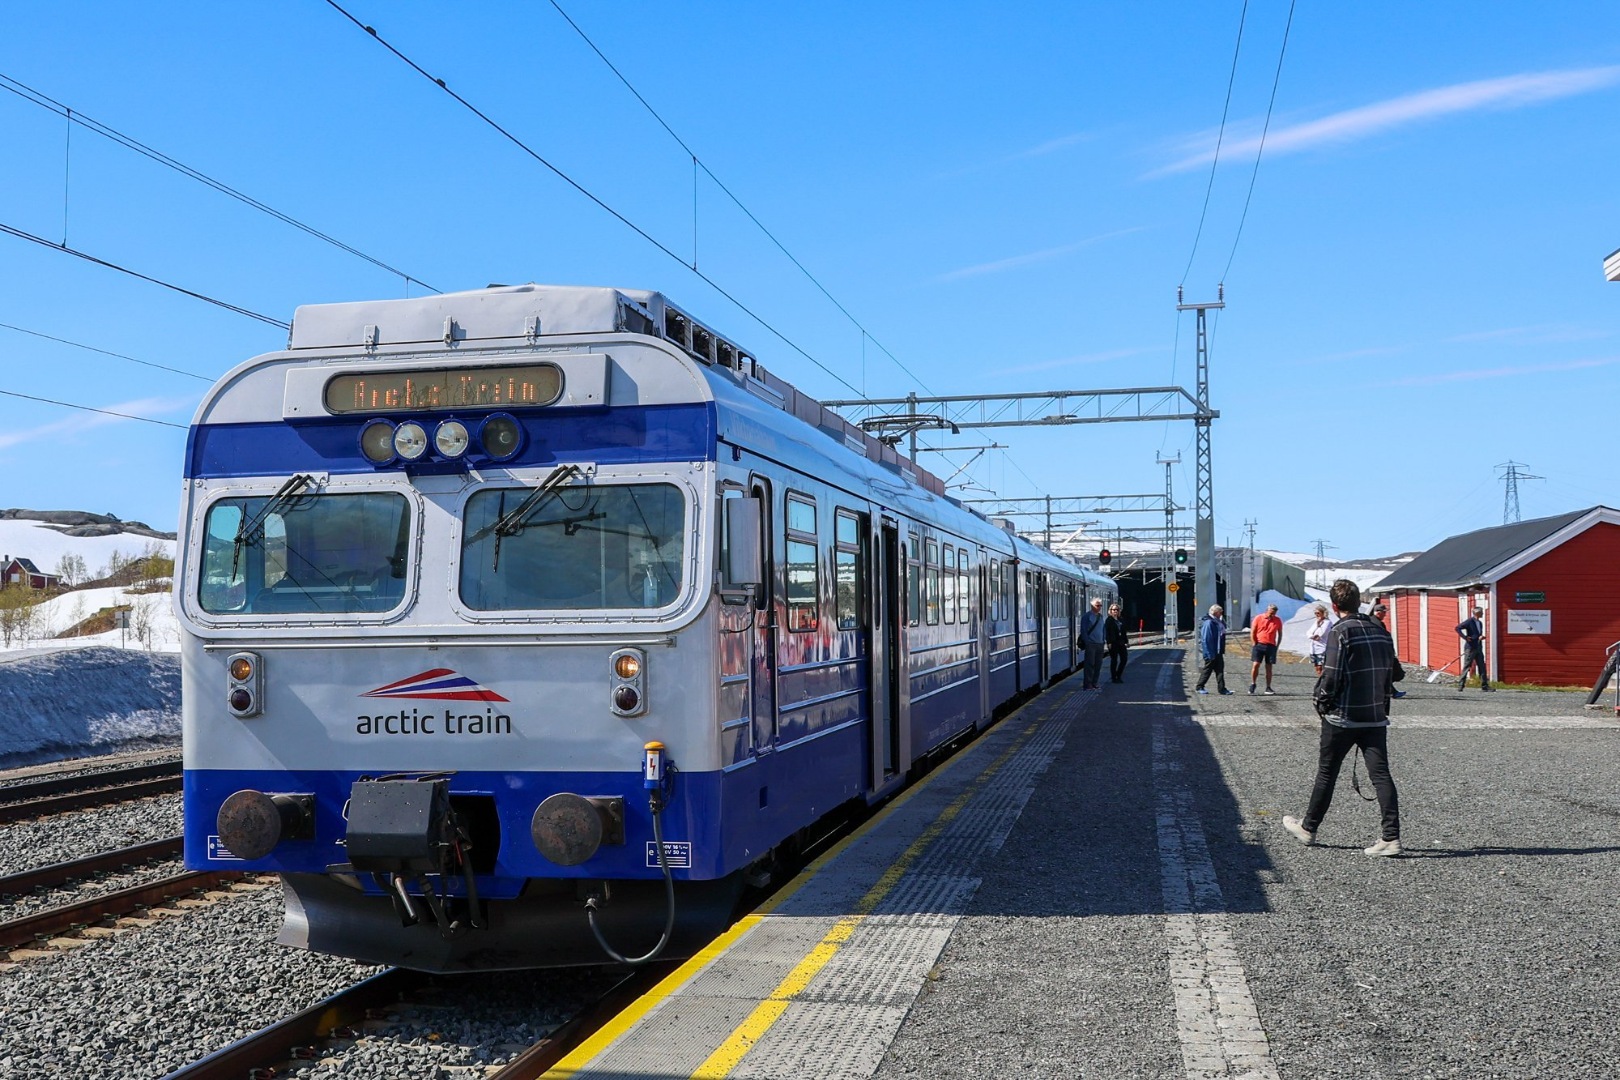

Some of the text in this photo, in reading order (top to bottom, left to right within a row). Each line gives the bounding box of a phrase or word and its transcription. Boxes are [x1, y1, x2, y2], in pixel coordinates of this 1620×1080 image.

[354, 379, 440, 407] Arctc
[356, 707, 512, 734] arctic train
